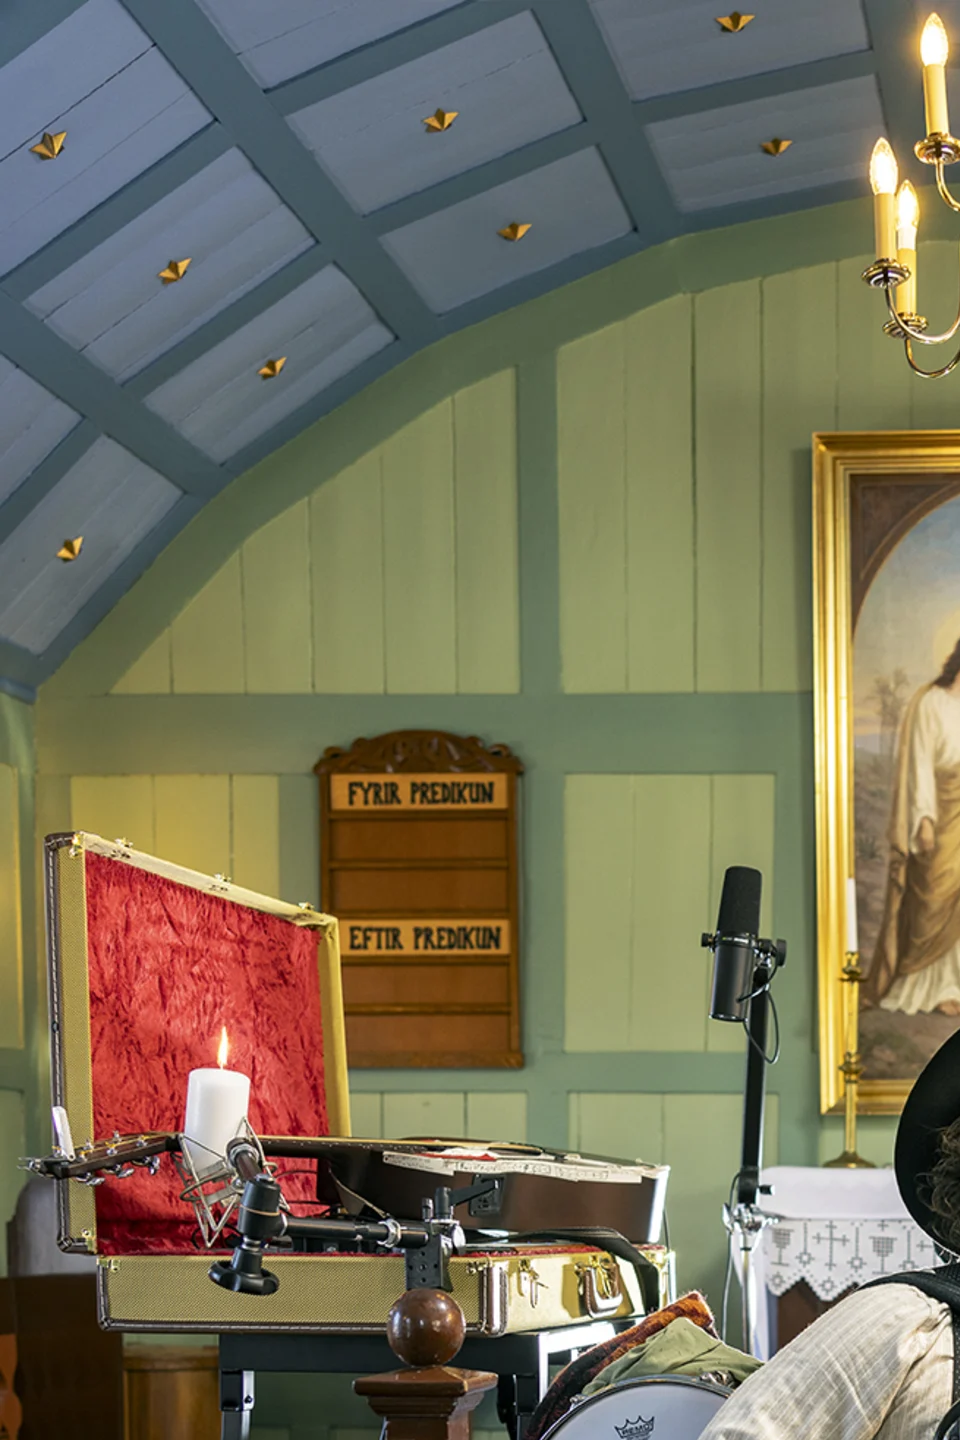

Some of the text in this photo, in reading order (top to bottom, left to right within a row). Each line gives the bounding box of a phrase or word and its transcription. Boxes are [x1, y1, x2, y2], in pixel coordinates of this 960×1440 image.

[348, 781, 495, 806] FYRIR PREDIKUN
[348, 926, 502, 950] EFTIR PREDIKUN
